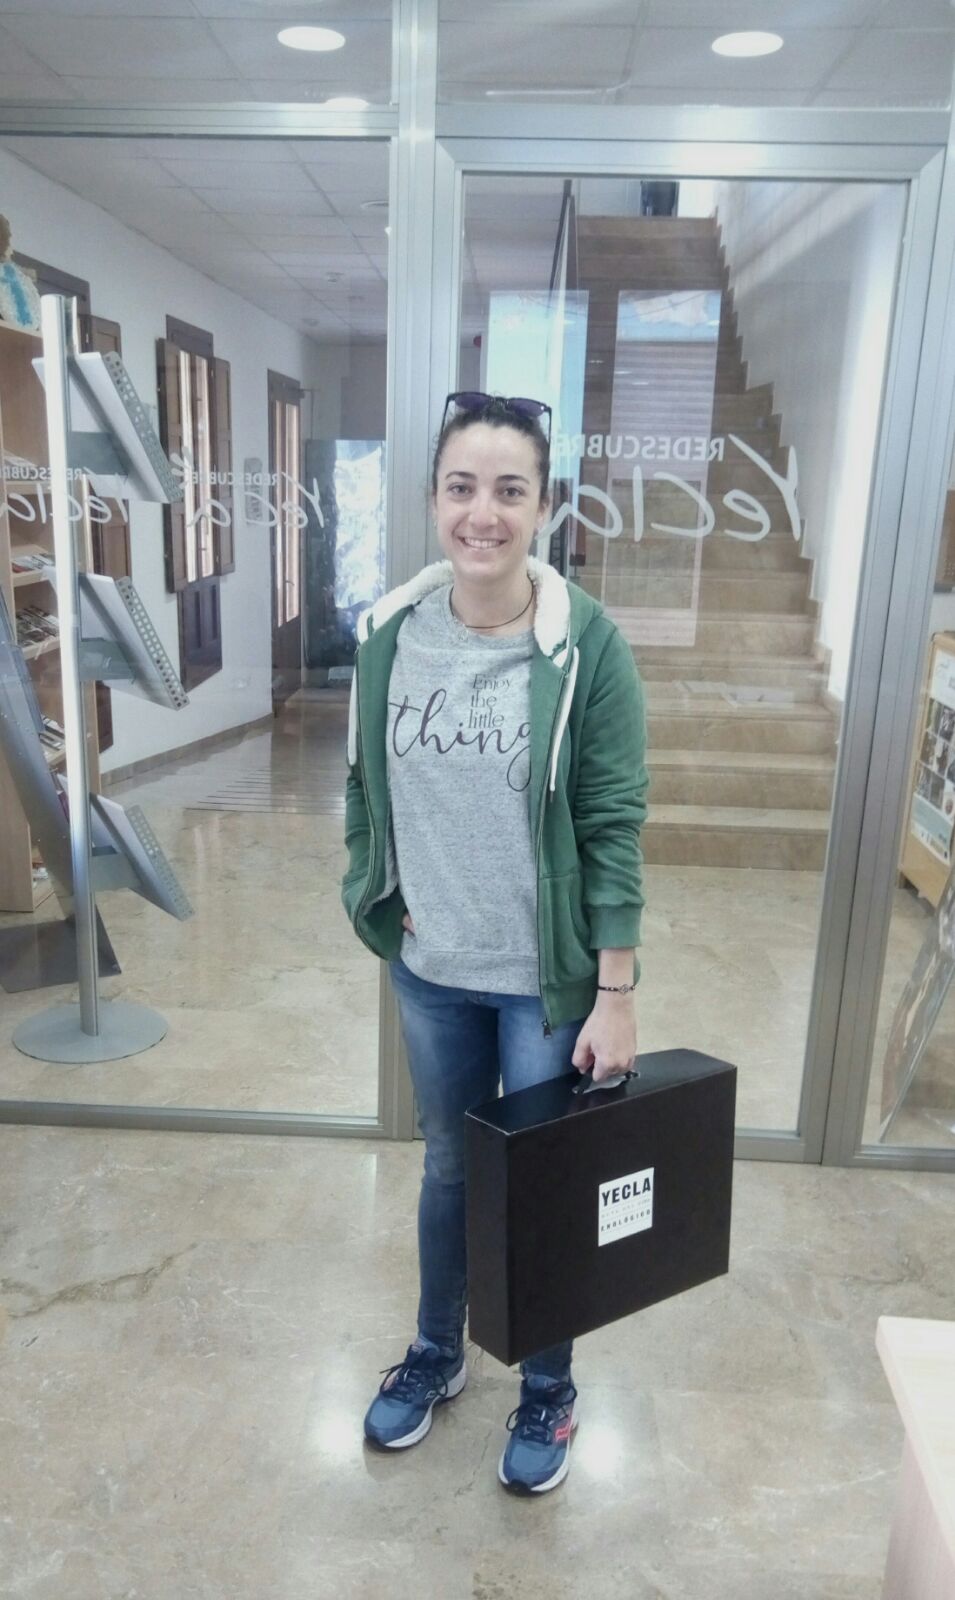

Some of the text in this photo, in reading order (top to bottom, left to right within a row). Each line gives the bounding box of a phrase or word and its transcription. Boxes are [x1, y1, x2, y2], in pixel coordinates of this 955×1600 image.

[472, 673, 511, 691] Enjoy
[470, 690, 497, 708] the
[468, 708, 505, 728] little
[601, 1177, 651, 1207] YECLA
